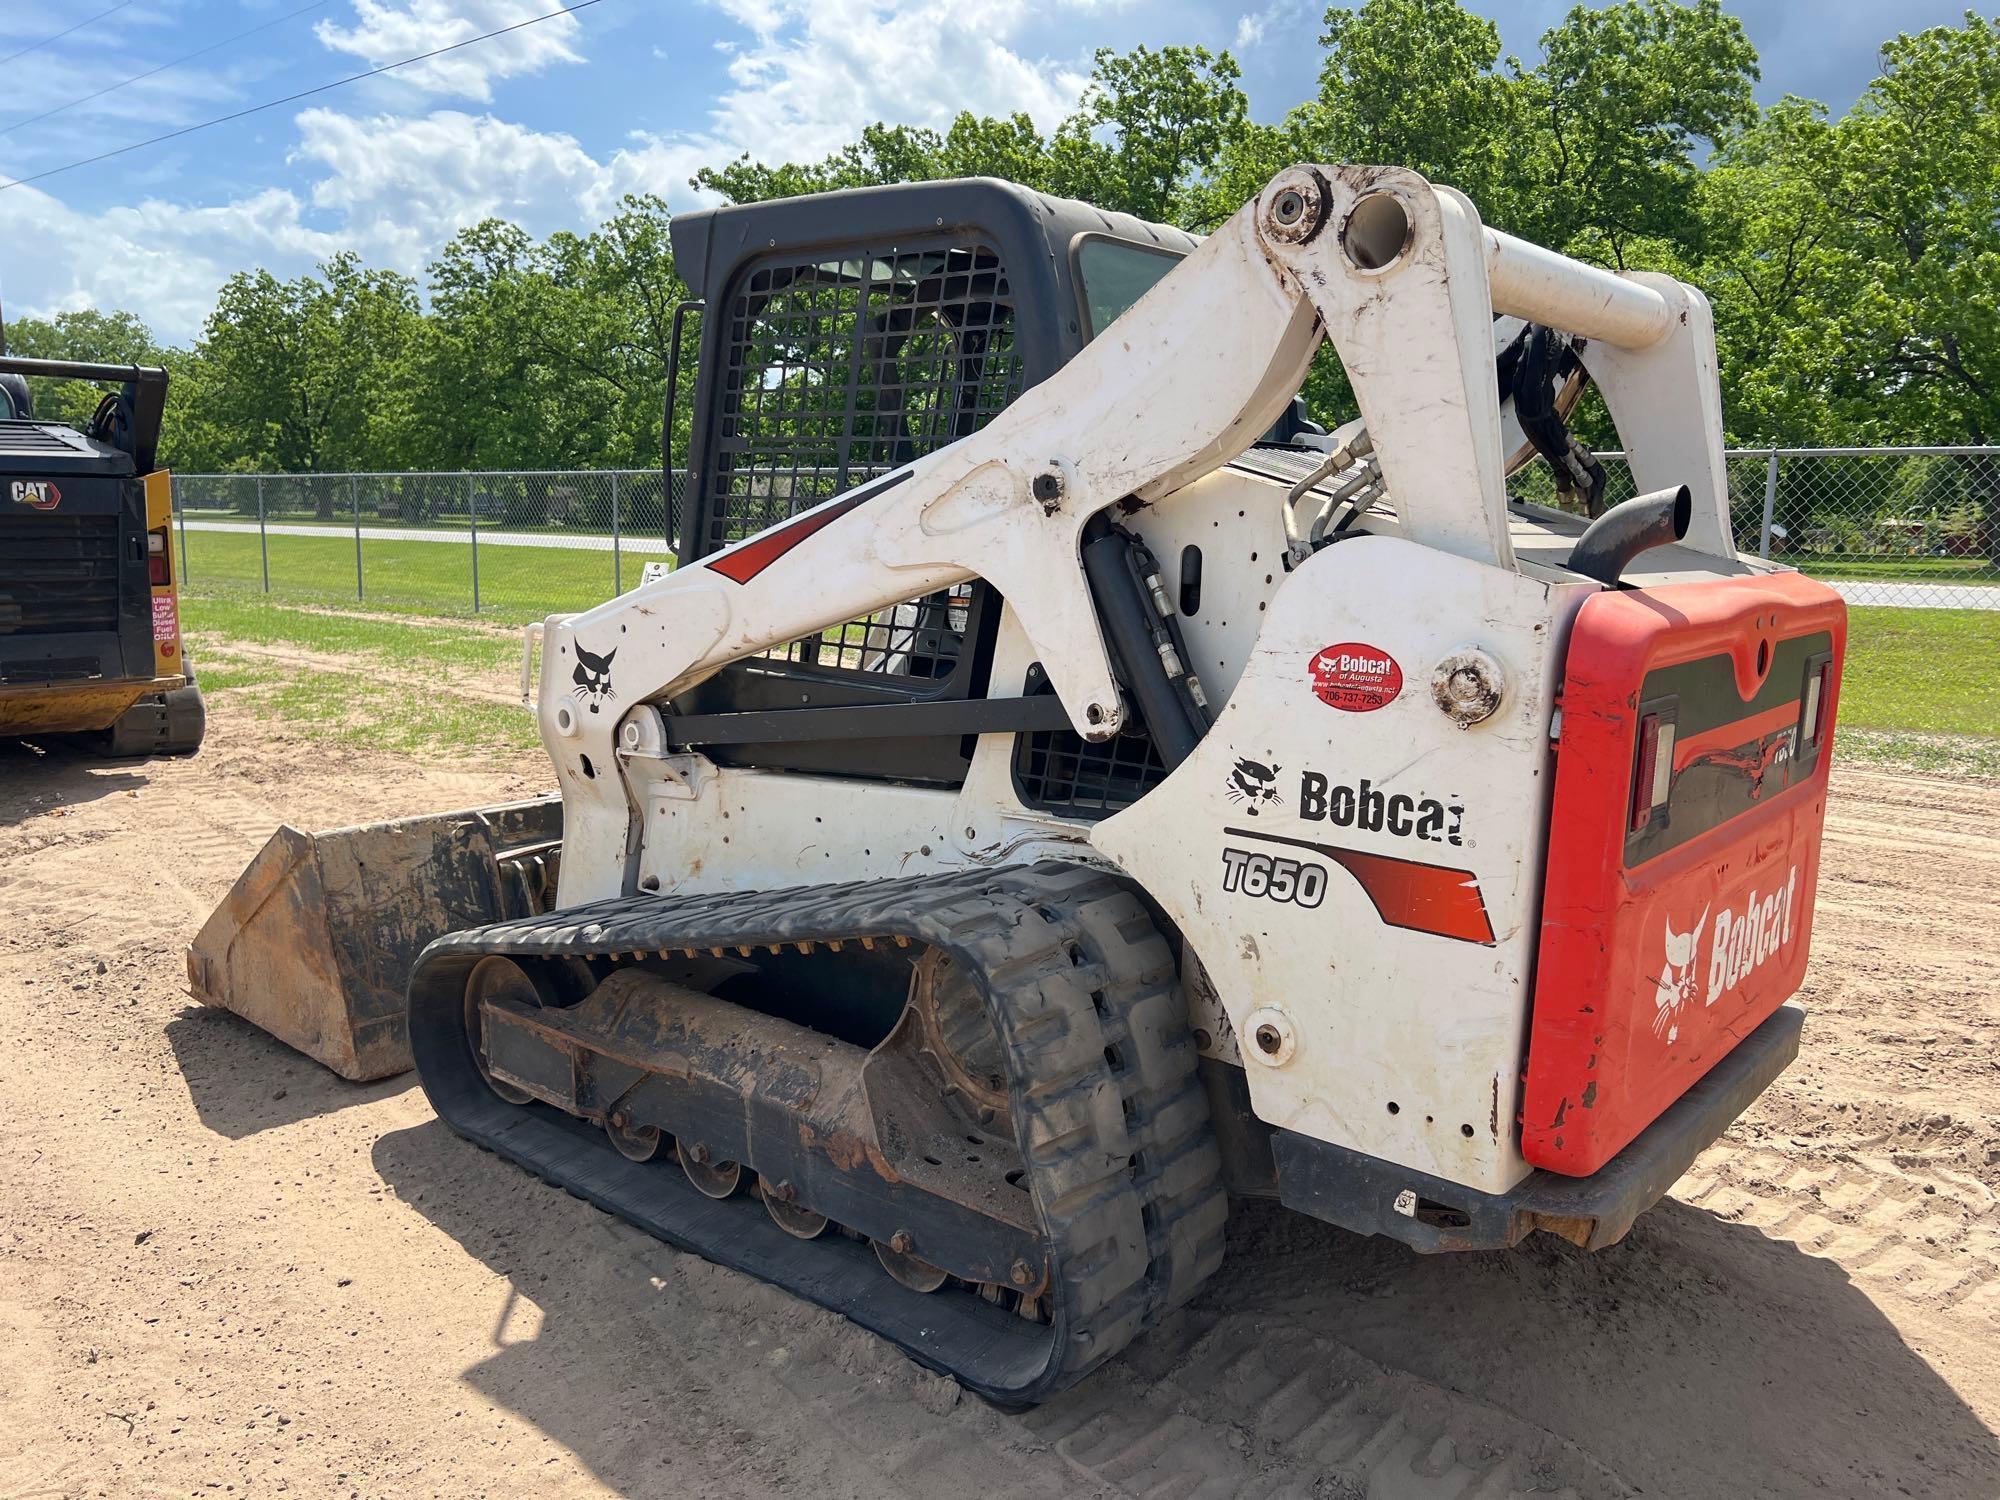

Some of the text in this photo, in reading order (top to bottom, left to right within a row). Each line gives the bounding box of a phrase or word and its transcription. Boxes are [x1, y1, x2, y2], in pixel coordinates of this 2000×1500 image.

[11, 481, 48, 503] CAT
[152, 618, 175, 626] Diesel
[1340, 654, 1392, 675] Bobcat
[1339, 672, 1383, 684] of Augusta
[1324, 690, 1383, 705] 706-737-7253
[1299, 770, 1466, 847] Bobcat
[1222, 846, 1329, 909] T650
[1705, 864, 1797, 1007] Bobcat
